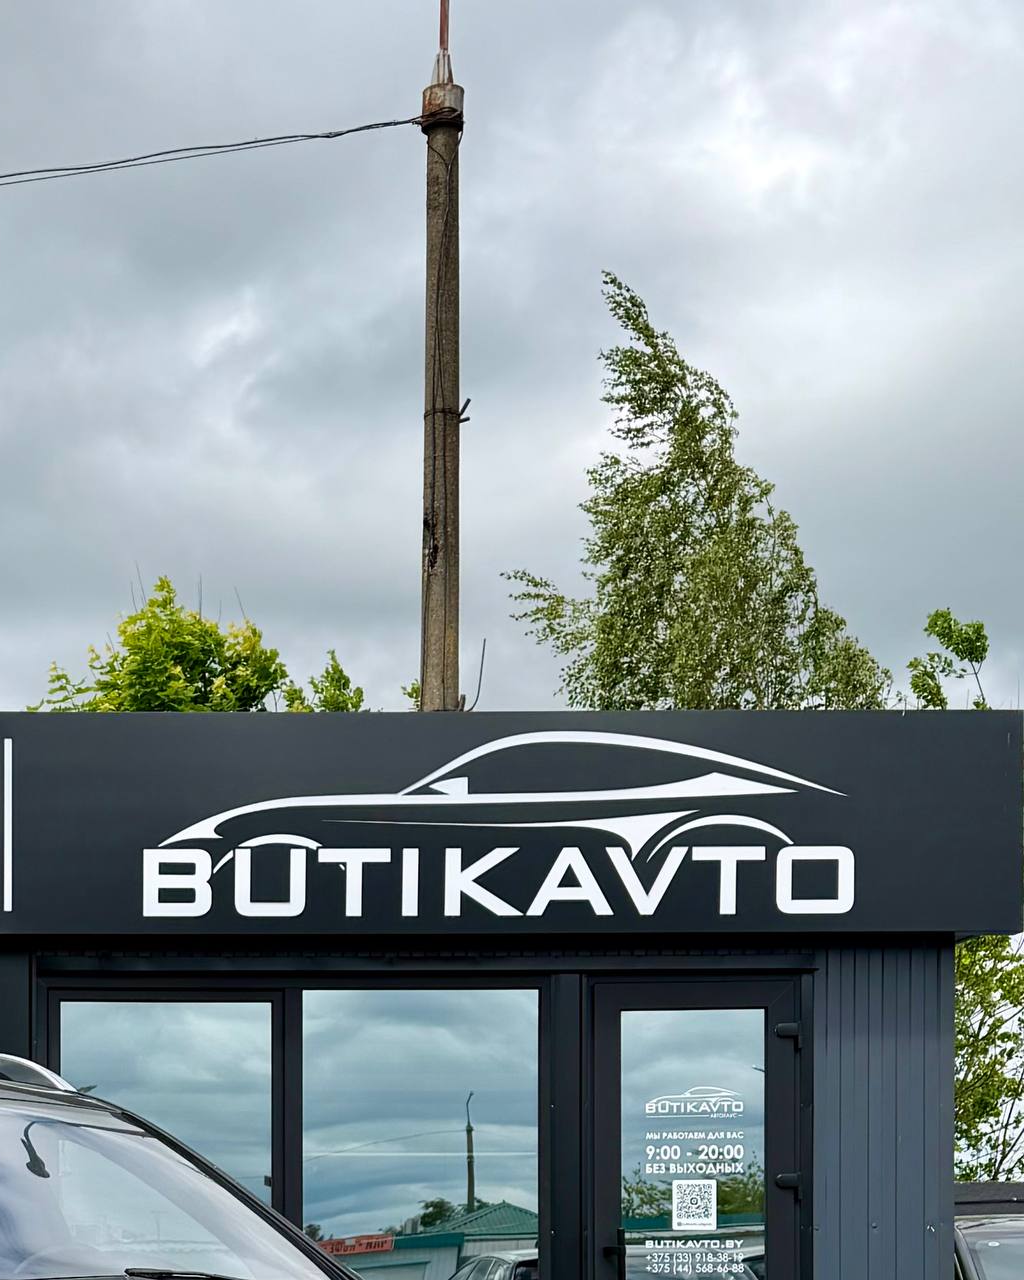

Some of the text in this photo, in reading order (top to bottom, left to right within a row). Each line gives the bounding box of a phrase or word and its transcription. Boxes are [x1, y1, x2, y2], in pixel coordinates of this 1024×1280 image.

[142, 845, 856, 917] BUTIKAVTO
[645, 1101, 744, 1113] BUTIKAVTO
[645, 1132, 661, 1140] МЫ
[707, 1132, 725, 1140] ДЛЯ
[645, 1145, 681, 1160] 9:00
[698, 1144, 744, 1160] 20:00
[645, 1162, 744, 1175] БЕЗ ВЫХОДНЫХ
[645, 1240, 744, 1249] BUTIKAVTO.BY
[645, 1252, 744, 1264] +375 (33) 918-38-19
[645, 1263, 745, 1275] +375 (44) 568-66-88
